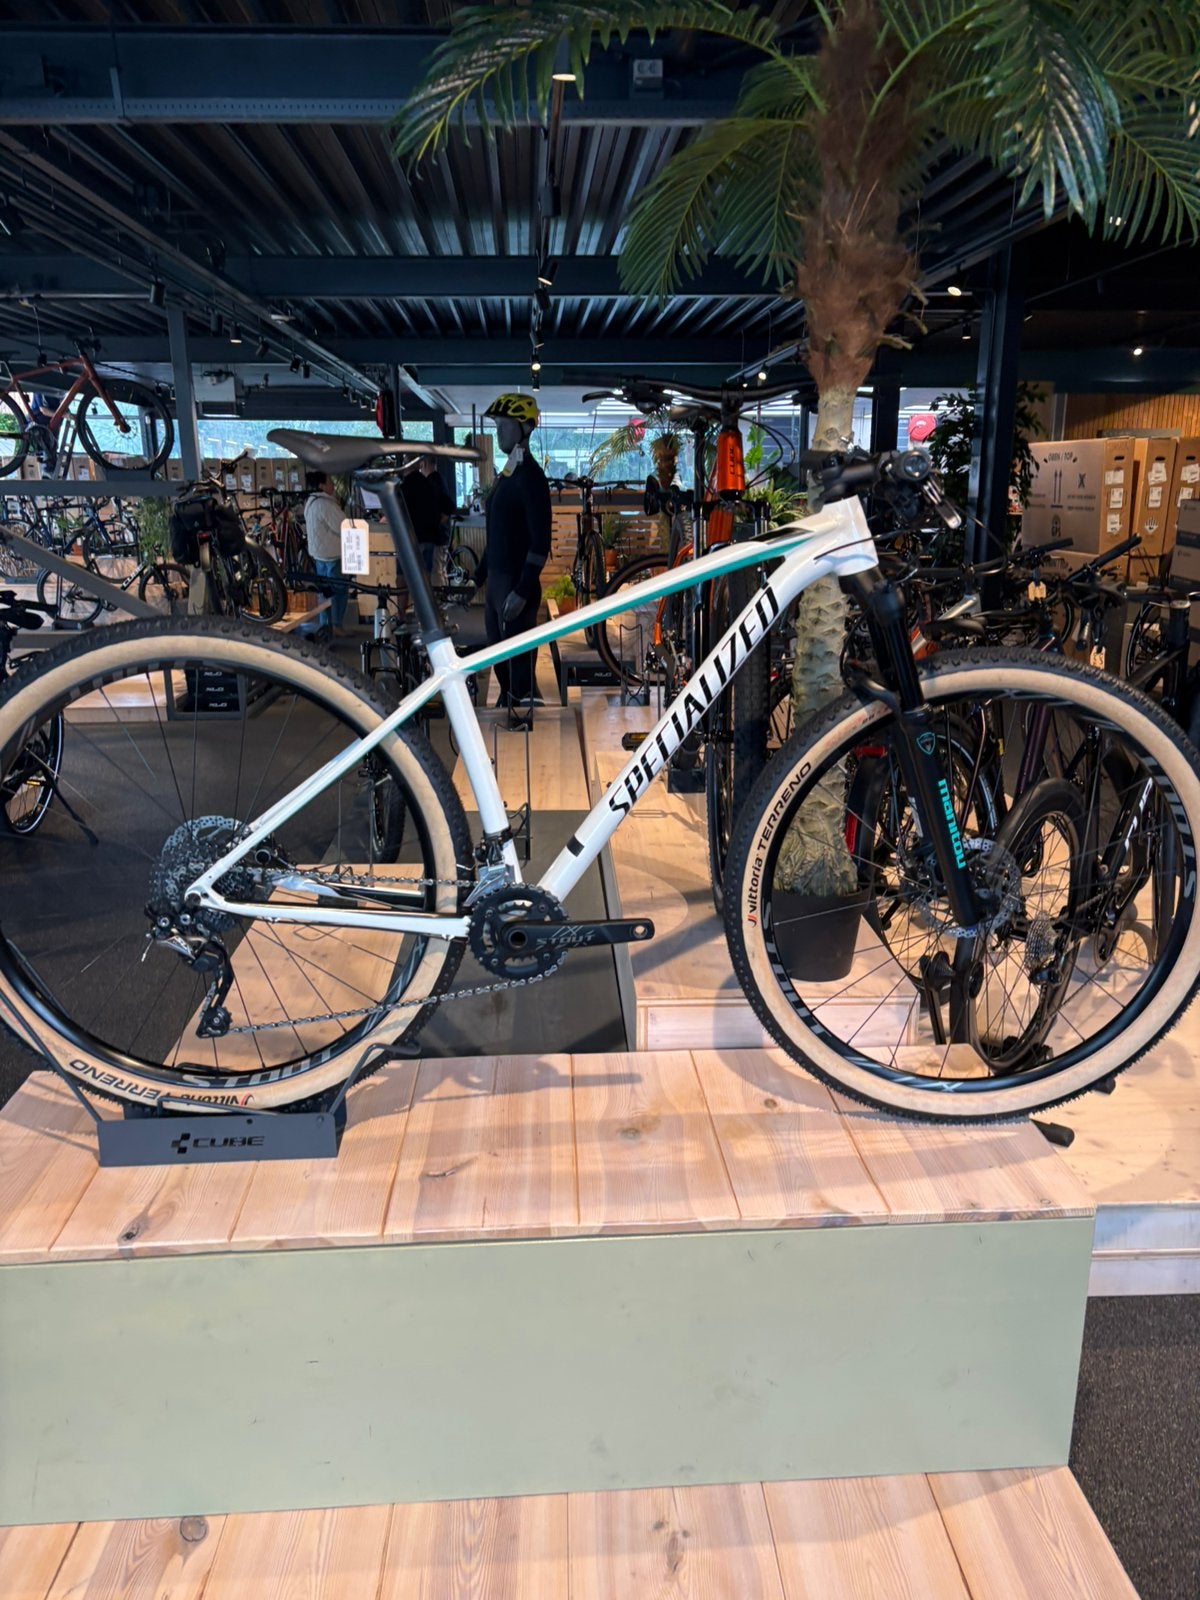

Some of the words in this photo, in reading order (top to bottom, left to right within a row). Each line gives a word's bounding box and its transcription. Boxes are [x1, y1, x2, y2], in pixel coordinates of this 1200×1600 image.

[609, 583, 779, 815] SPECIALIZED
[757, 762, 812, 851] TERRENO
[938, 779, 966, 869] manitou
[69, 1058, 171, 1102] ERRENO
[193, 1136, 266, 1148] CUBE
